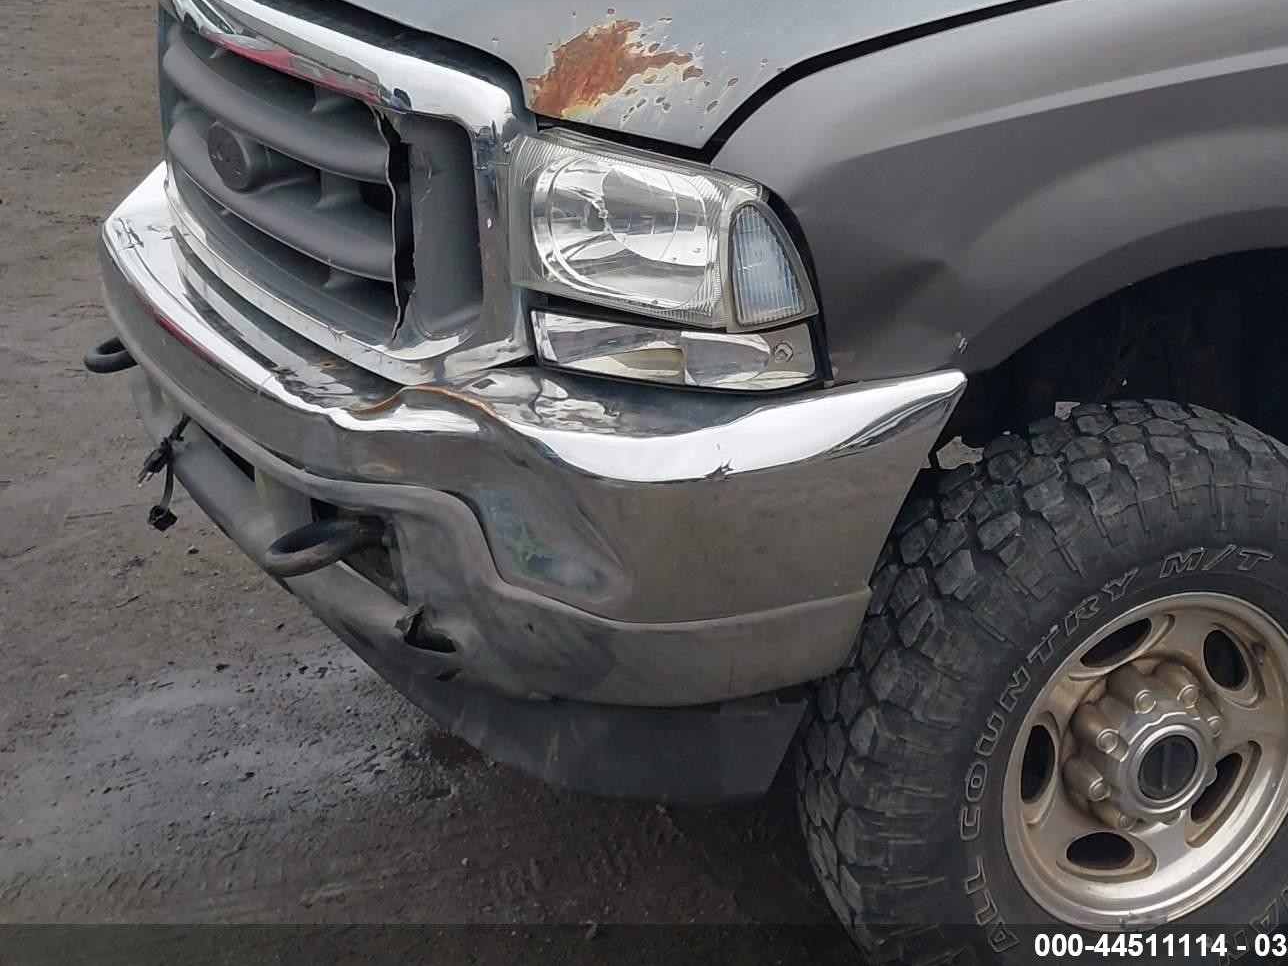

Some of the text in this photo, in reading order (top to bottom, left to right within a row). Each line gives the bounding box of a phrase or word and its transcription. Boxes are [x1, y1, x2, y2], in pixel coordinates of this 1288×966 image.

[960, 543, 1274, 953] ALL COUNTRY M/T
